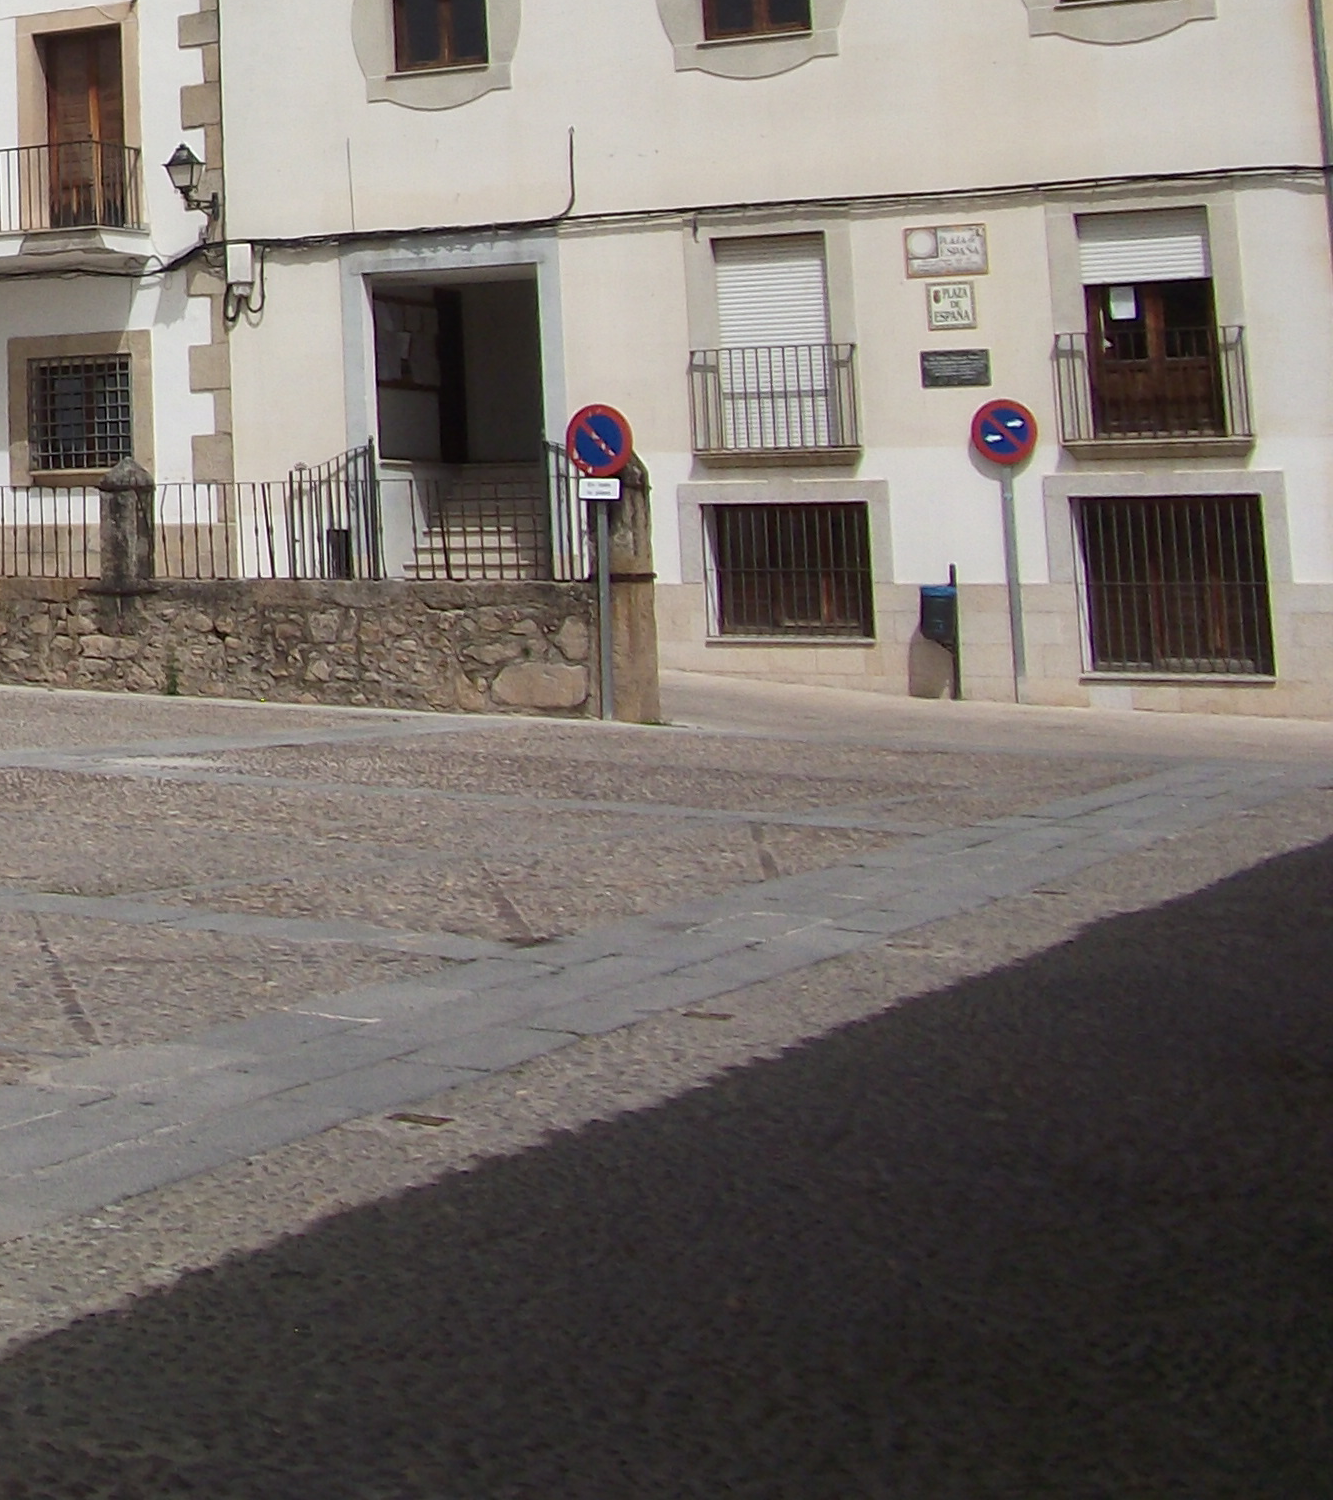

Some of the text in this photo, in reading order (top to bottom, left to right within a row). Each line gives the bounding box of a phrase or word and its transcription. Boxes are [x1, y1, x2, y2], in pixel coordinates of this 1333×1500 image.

[942, 286, 968, 300] PLAZA
[950, 300, 960, 309] DE
[934, 309, 971, 323] ESPAÑA
